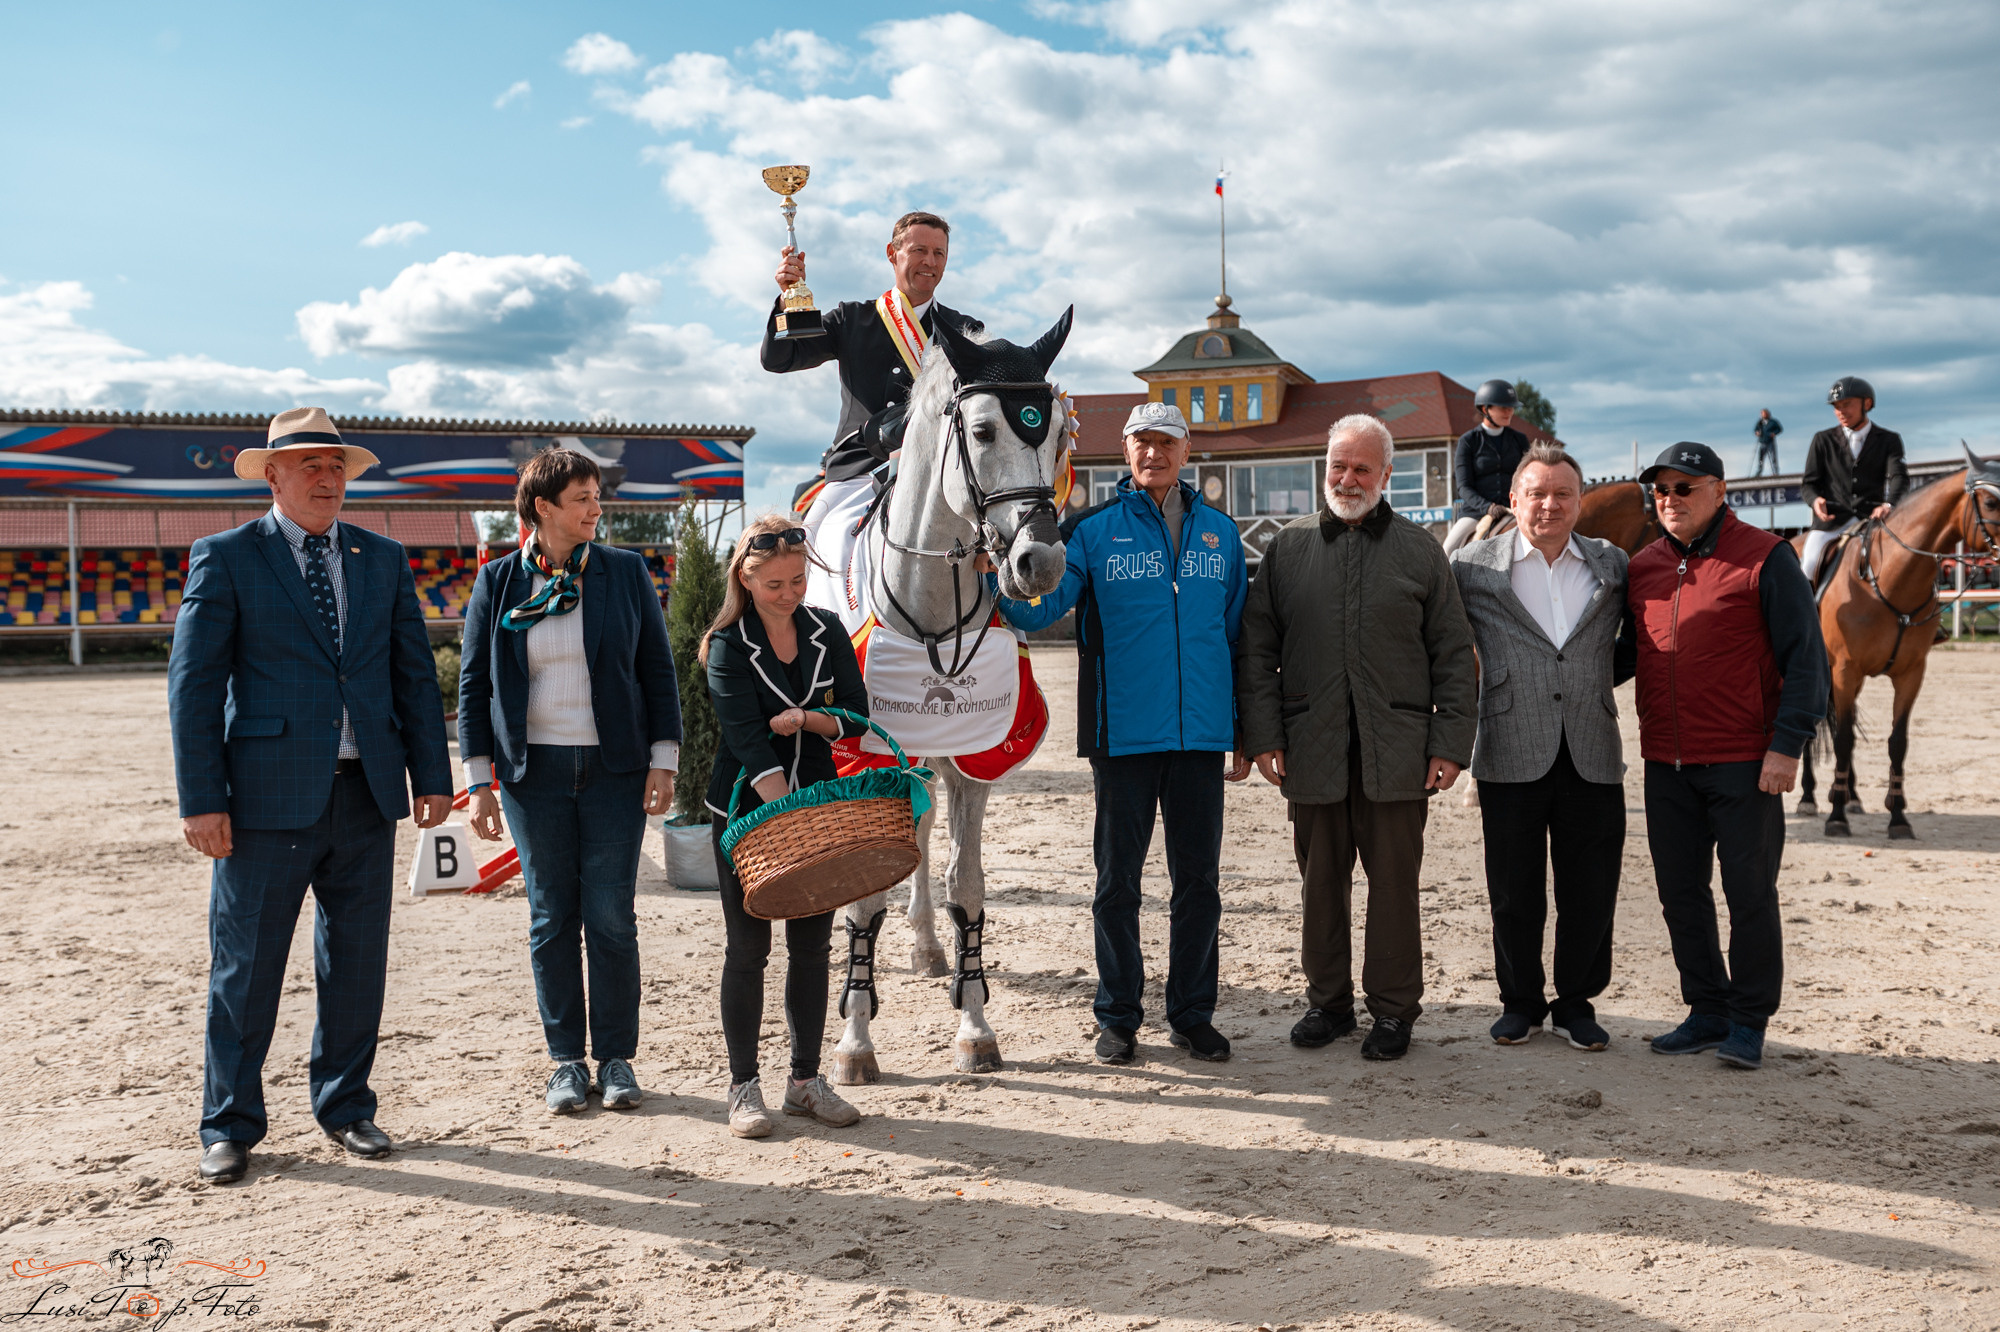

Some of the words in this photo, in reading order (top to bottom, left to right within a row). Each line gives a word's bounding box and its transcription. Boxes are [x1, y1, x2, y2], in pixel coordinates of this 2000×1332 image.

[871, 696, 939, 715] КОНАКОВСКИЕ
[956, 691, 1012, 715] КОНЮШНИ
[434, 835, 458, 879] B
